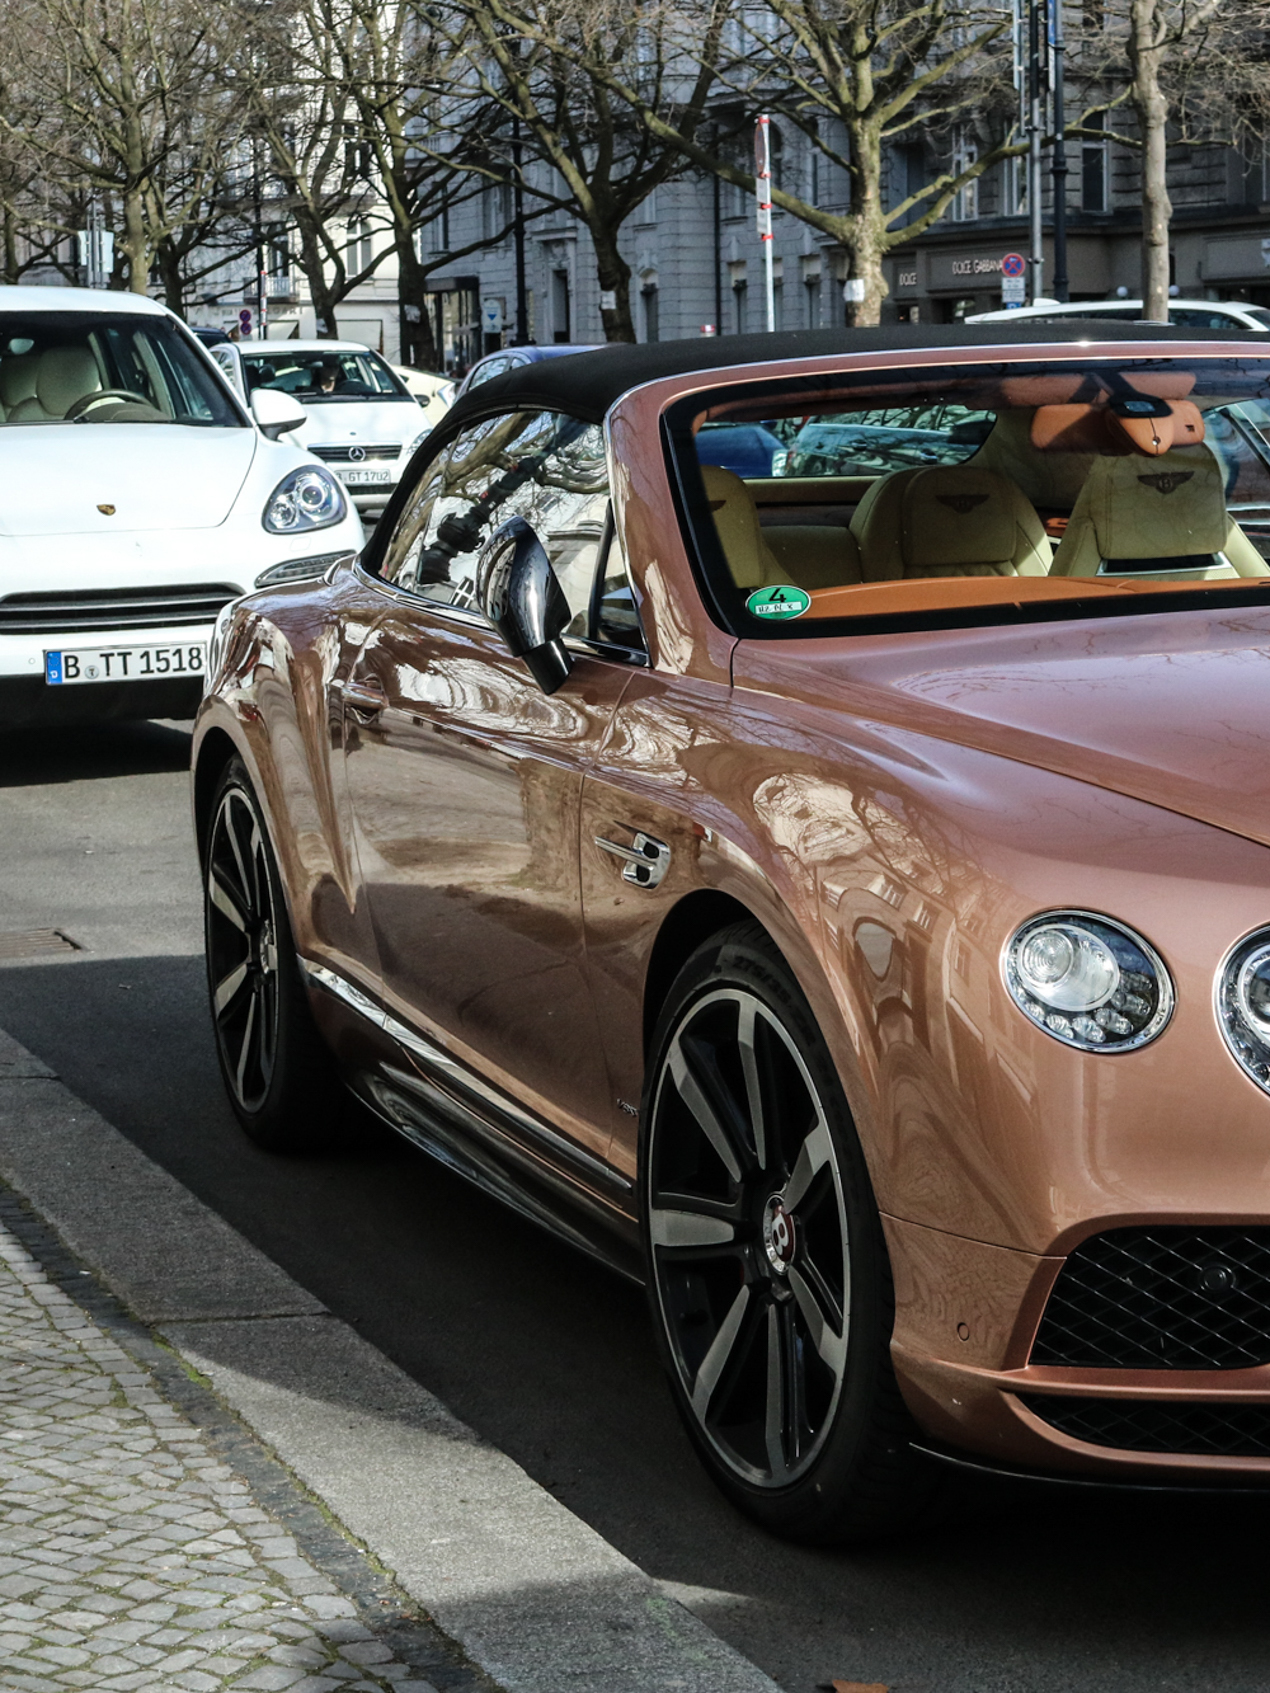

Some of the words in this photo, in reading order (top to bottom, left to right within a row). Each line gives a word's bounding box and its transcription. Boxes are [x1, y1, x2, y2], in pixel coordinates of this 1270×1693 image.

[349, 471, 362, 482] GT
[769, 588, 787, 603] 4
[64, 655, 81, 679] B
[99, 651, 133, 677] TT
[140, 647, 204, 675] 1518
